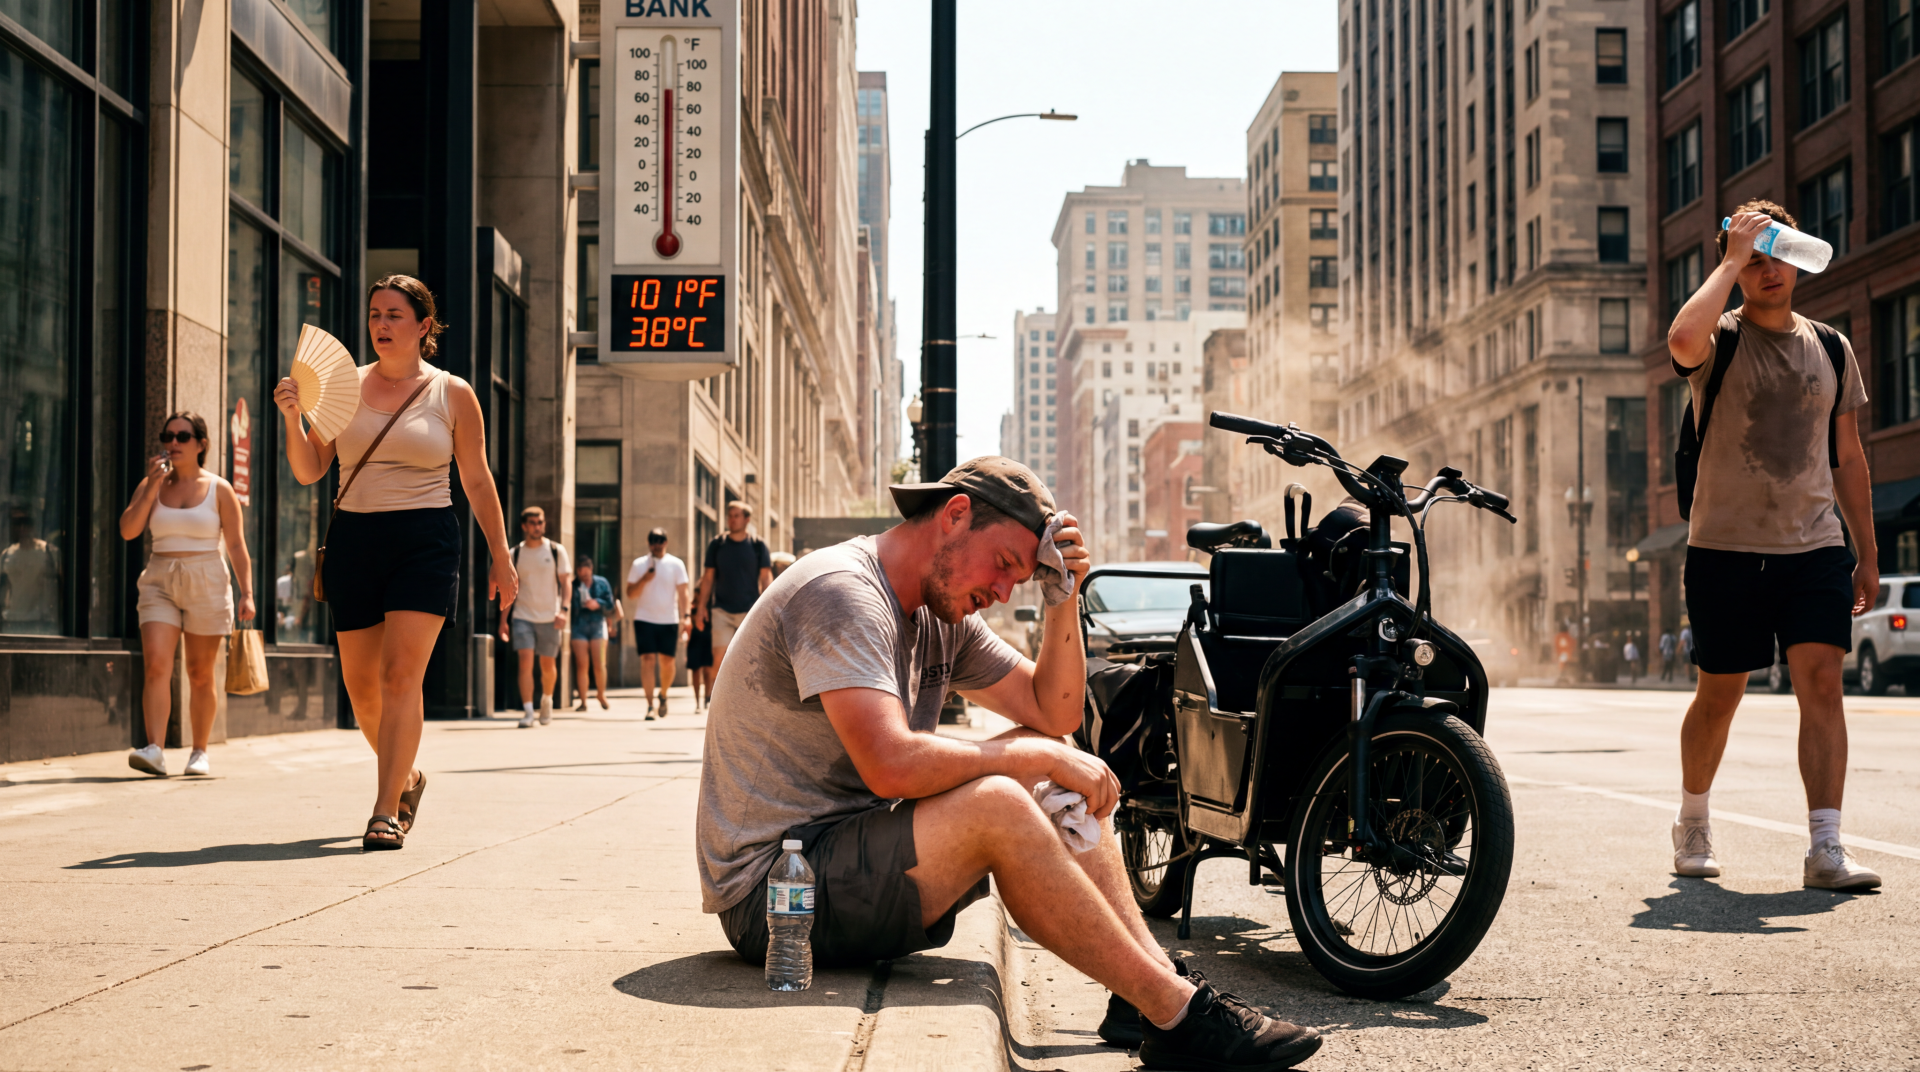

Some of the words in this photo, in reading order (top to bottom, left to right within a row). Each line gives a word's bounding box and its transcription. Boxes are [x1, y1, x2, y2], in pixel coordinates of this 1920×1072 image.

[625, 0, 712, 18] BANK
[630, 48, 651, 58] 100
[686, 59, 707, 70] 100
[634, 70, 650, 81] 80
[686, 81, 702, 92] 80
[634, 92, 650, 103] 60
[686, 103, 702, 115] 60
[634, 114, 650, 126] 40
[686, 126, 702, 137] 40
[634, 136, 650, 148] 20
[686, 148, 702, 159] 20
[638, 159, 646, 170] 0
[689, 170, 697, 181] 0
[633, 181, 650, 192] 20
[686, 192, 702, 203] 20
[633, 203, 650, 215] 40
[686, 214, 702, 226] 40
[629, 316, 707, 348] 38°C
